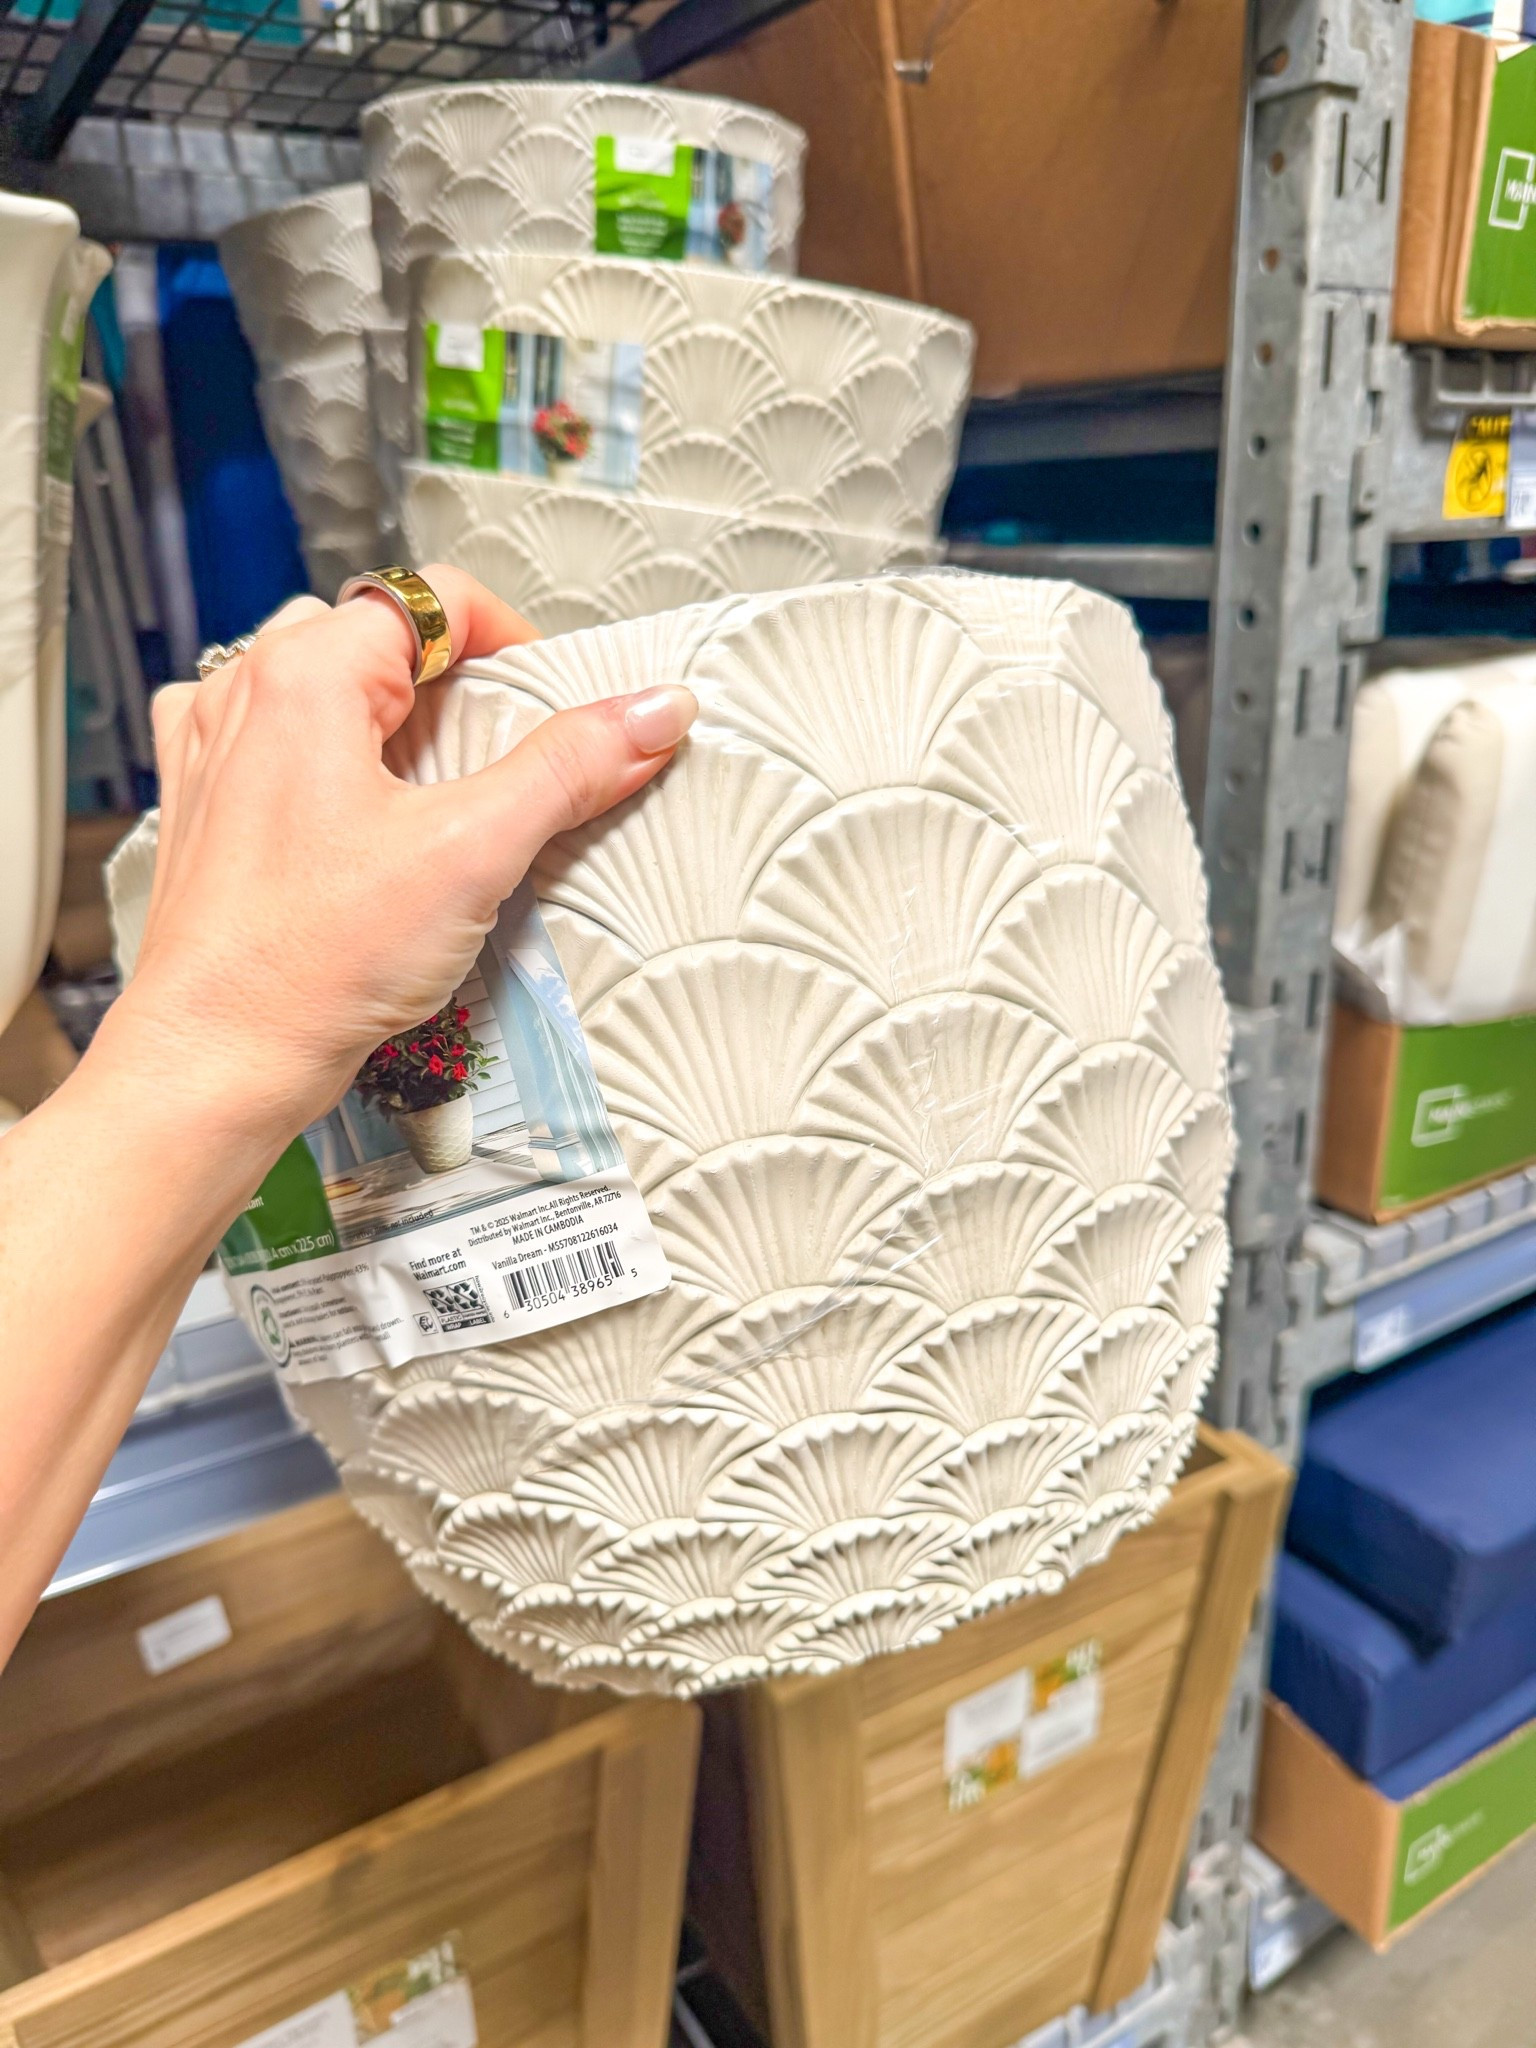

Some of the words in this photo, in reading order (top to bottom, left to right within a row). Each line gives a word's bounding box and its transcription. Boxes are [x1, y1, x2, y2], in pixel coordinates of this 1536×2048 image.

[402, 1208, 434, 1225] included
[468, 1230, 504, 1247] Distributed
[504, 1226, 512, 1237] by
[511, 1217, 540, 1233] Walmart
[554, 1201, 594, 1219] Bentonville,
[594, 1196, 604, 1206] AR
[602, 1190, 622, 1204] 72716
[470, 1225, 482, 1236] TM
[494, 1216, 510, 1228] 2025
[509, 1207, 538, 1222] Walmart
[558, 1193, 580, 1208] Rights
[512, 1231, 535, 1246] MADE
[535, 1227, 544, 1238] IN
[544, 1214, 585, 1235] CAMBODIA
[409, 1257, 427, 1271] Find
[427, 1252, 451, 1267] more
[452, 1247, 462, 1259] at
[491, 1252, 518, 1270] Vanilla
[517, 1246, 544, 1262] Dream
[413, 1259, 467, 1282] Walmart.com
[503, 1310, 510, 1319] 6
[524, 1289, 566, 1313] 30504
[570, 1274, 614, 1298] 38965
[630, 1267, 638, 1278] 5
[440, 1314, 462, 1324] PLASTIC
[468, 1317, 488, 1326] LABEL
